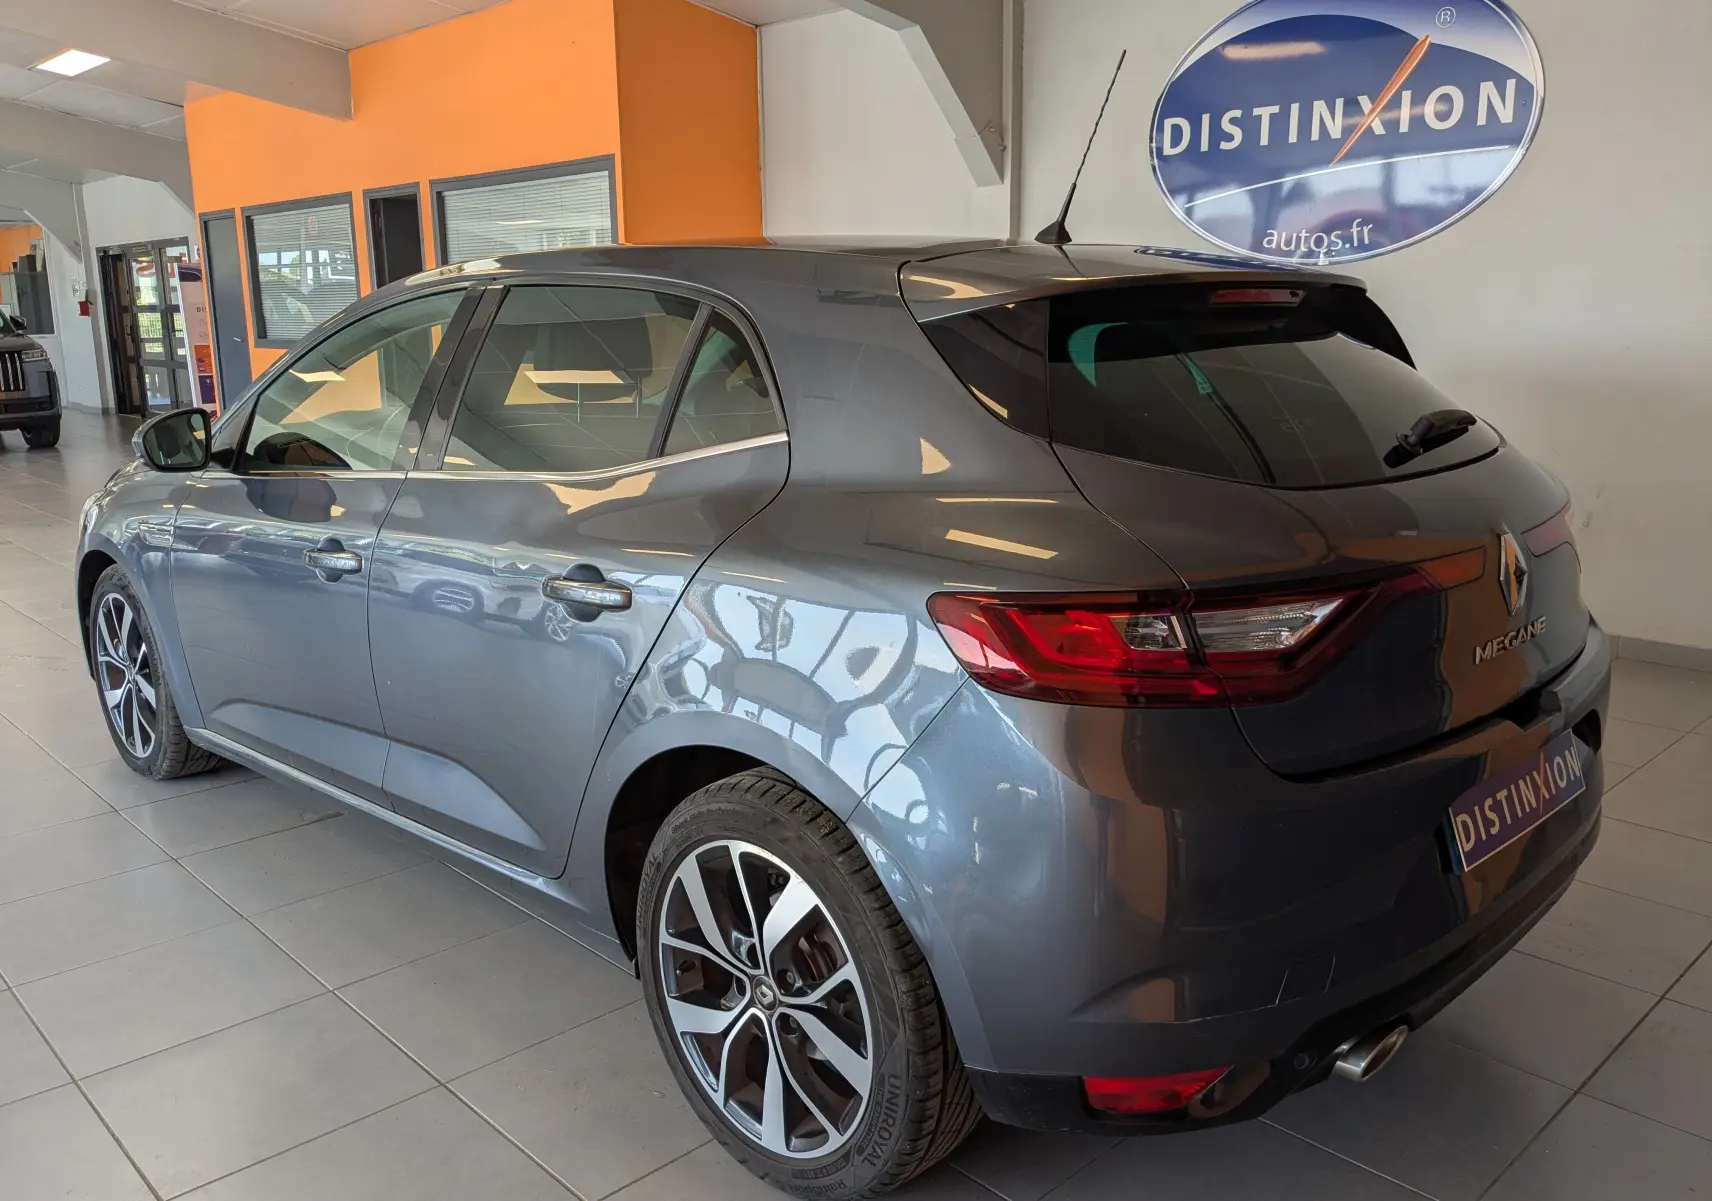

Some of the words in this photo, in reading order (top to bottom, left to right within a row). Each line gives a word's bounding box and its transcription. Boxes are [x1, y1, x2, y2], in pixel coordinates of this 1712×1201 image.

[1161, 77, 1518, 157] DISTINXION
[1262, 217, 1374, 252] autos.fr
[1474, 616, 1547, 665] MEGANE
[1455, 746, 1581, 852] DISTINXION
[861, 1073, 901, 1168] UNIROYAL
